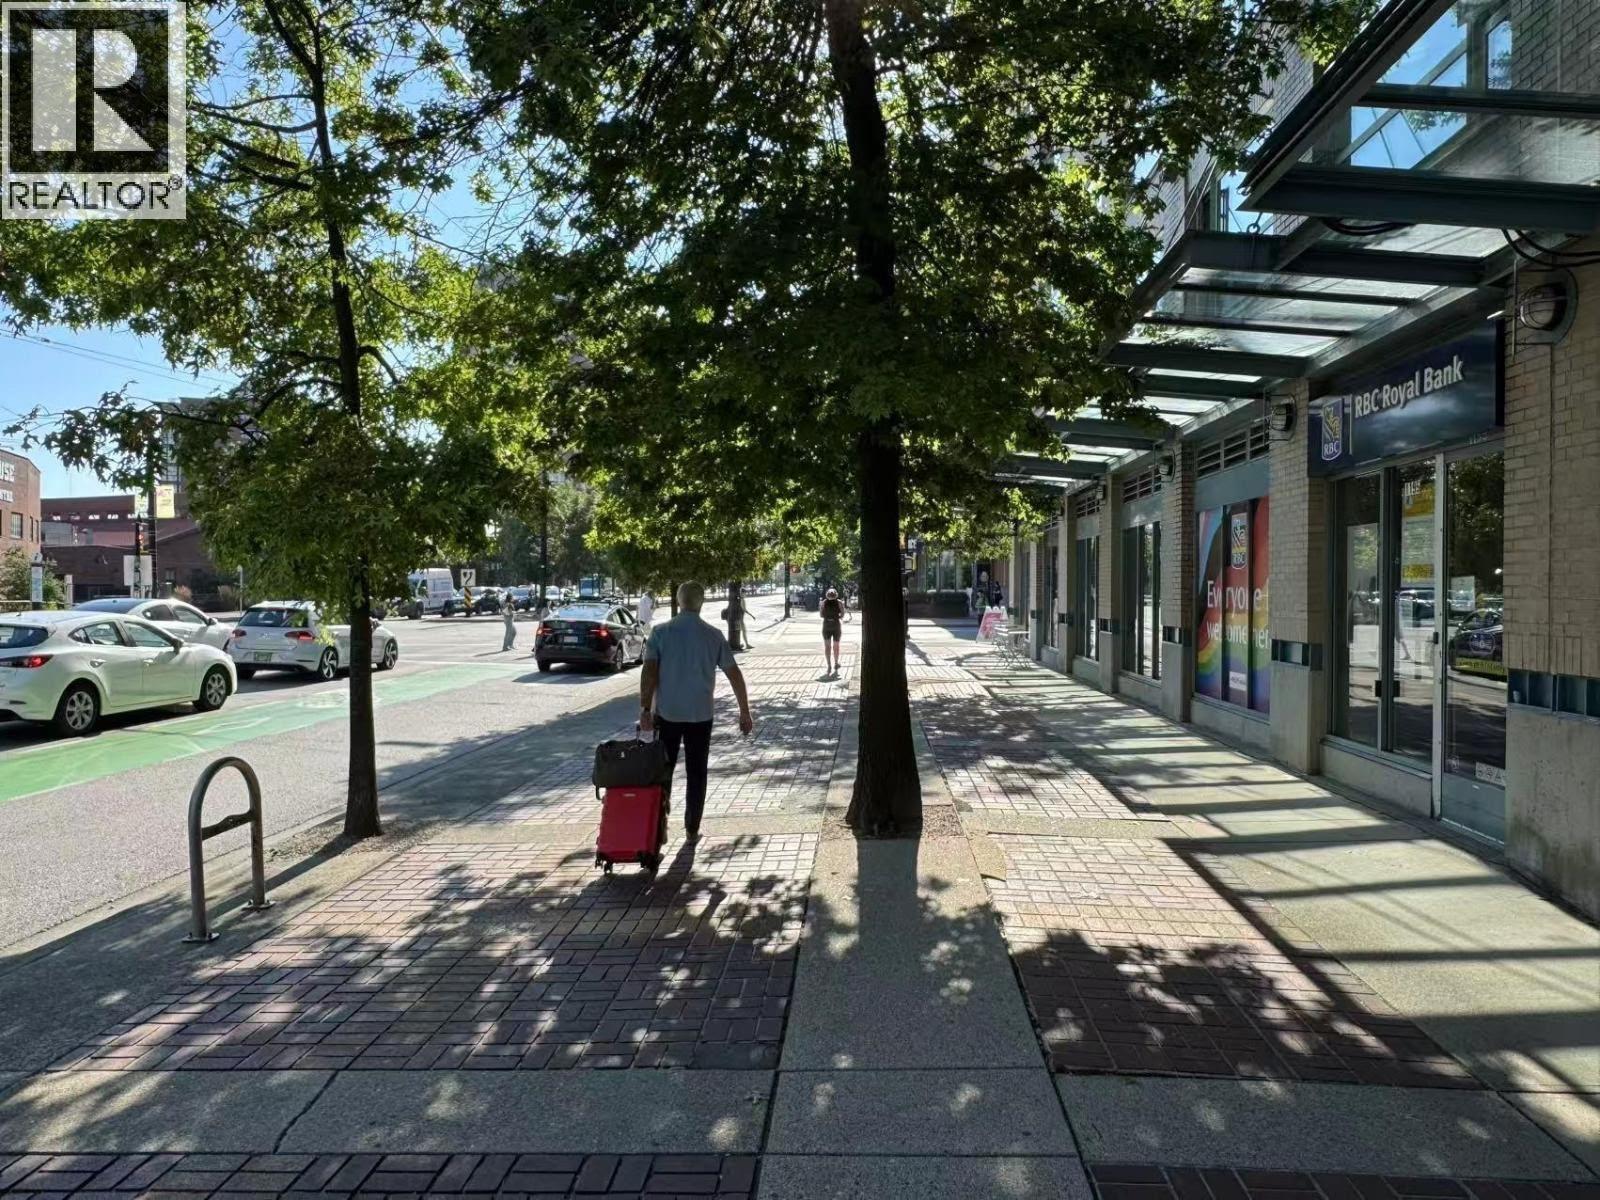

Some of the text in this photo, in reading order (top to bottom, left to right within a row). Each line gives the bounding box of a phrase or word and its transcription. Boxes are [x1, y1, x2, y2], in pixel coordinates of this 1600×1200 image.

[1354, 354, 1464, 419] RBC Royal Bank
[1323, 440, 1341, 456] RBC
